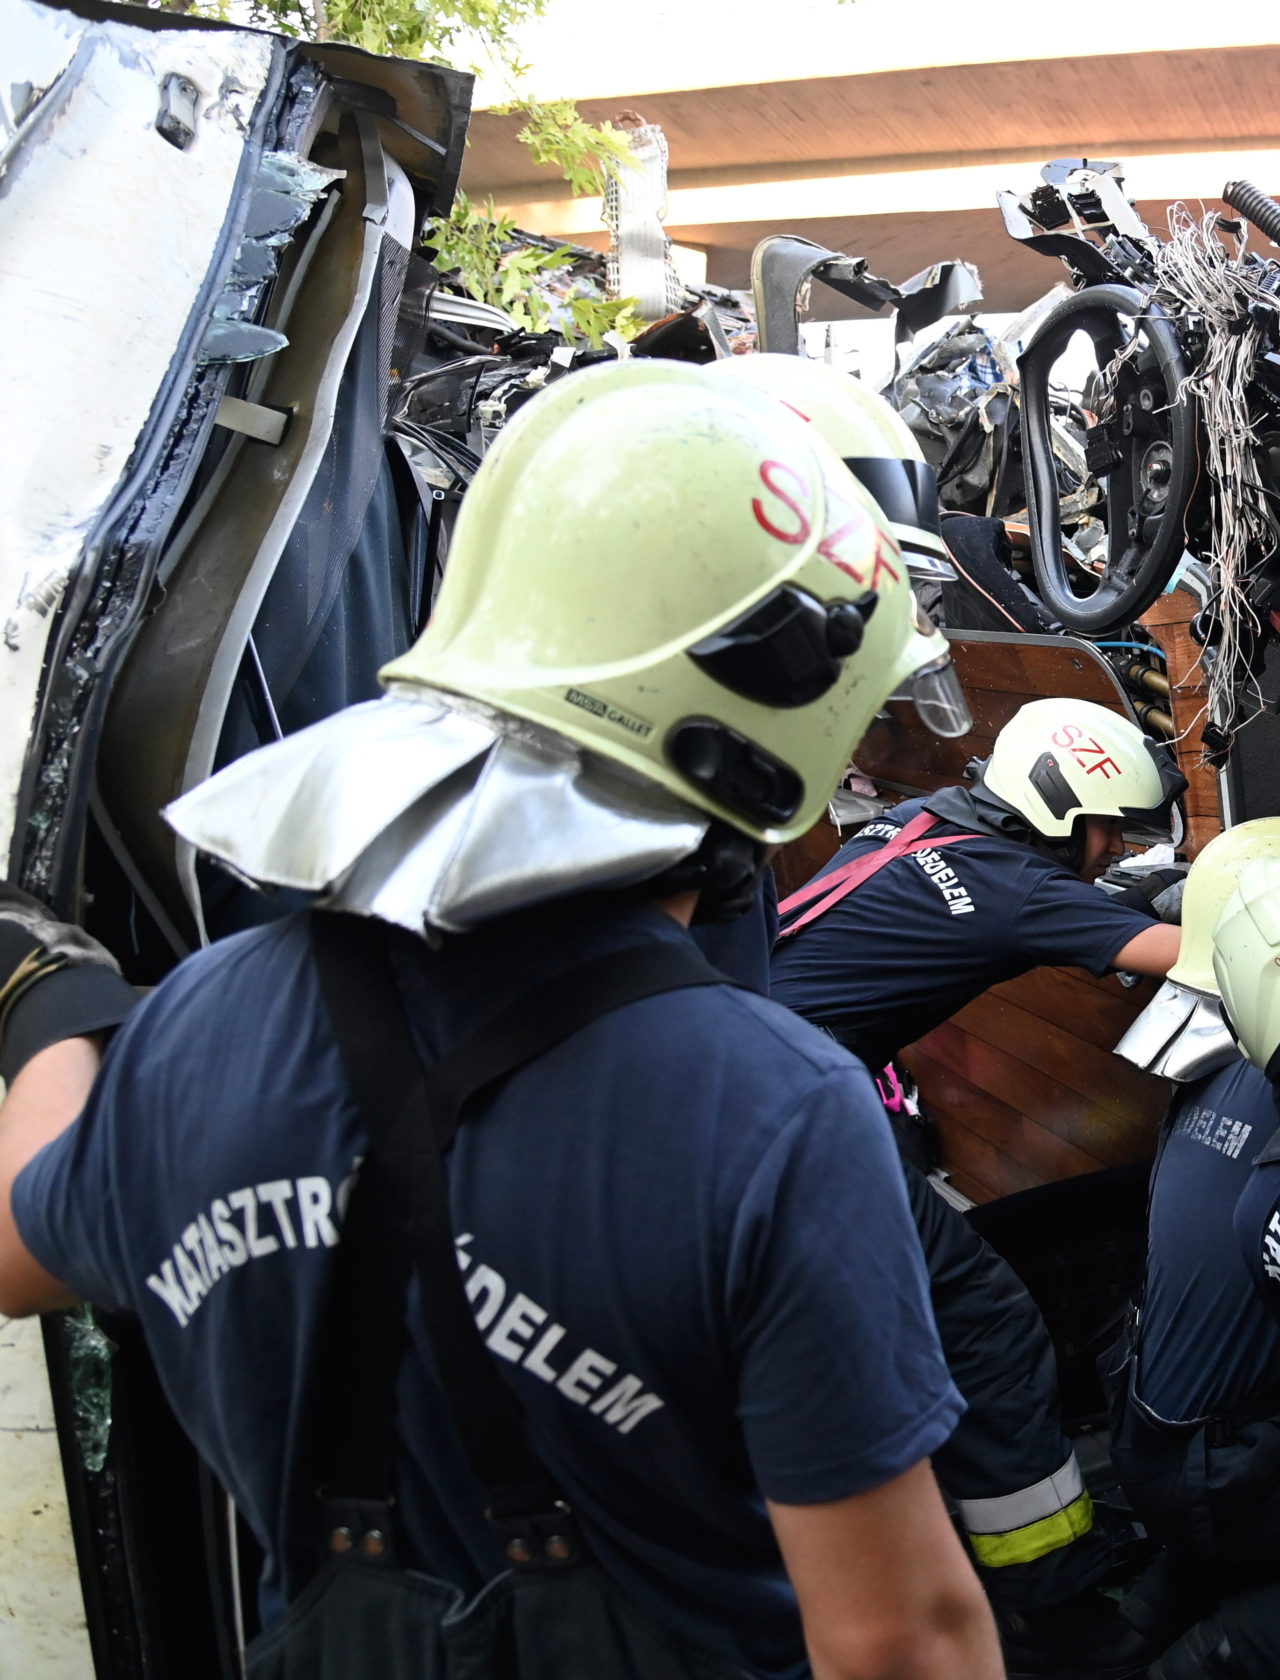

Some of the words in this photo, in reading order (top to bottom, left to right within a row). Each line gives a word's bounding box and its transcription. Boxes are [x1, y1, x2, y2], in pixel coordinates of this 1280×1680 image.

[752, 459, 901, 590] SZF
[1052, 725, 1122, 779] SZF
[1174, 1105, 1253, 1159] DELEM
